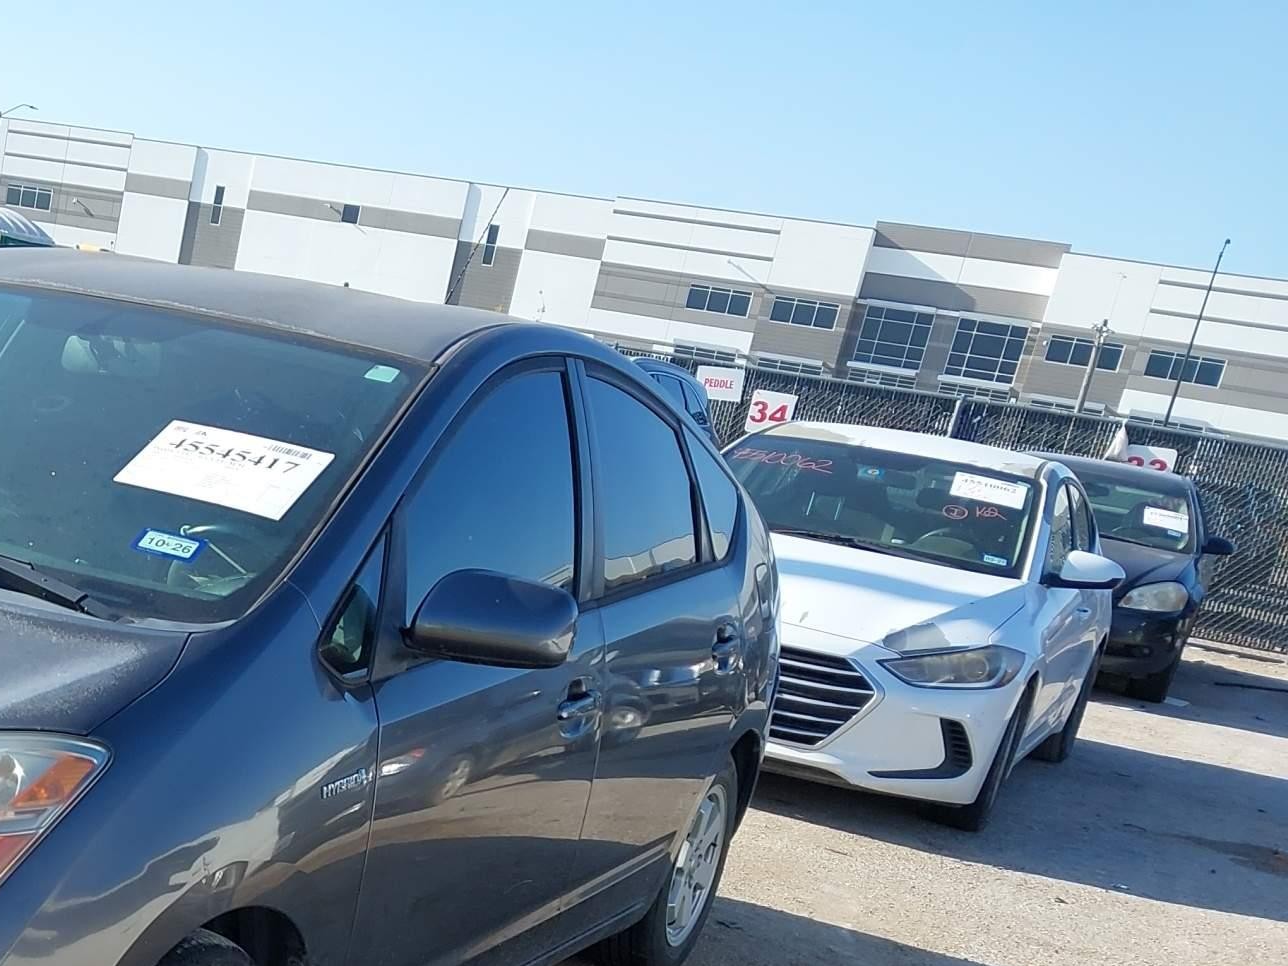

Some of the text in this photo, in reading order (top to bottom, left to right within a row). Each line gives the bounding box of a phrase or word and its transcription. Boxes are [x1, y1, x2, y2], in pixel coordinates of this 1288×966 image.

[704, 377, 734, 390] PEDDLE
[749, 400, 789, 423] 34
[169, 438, 301, 474] 45545417
